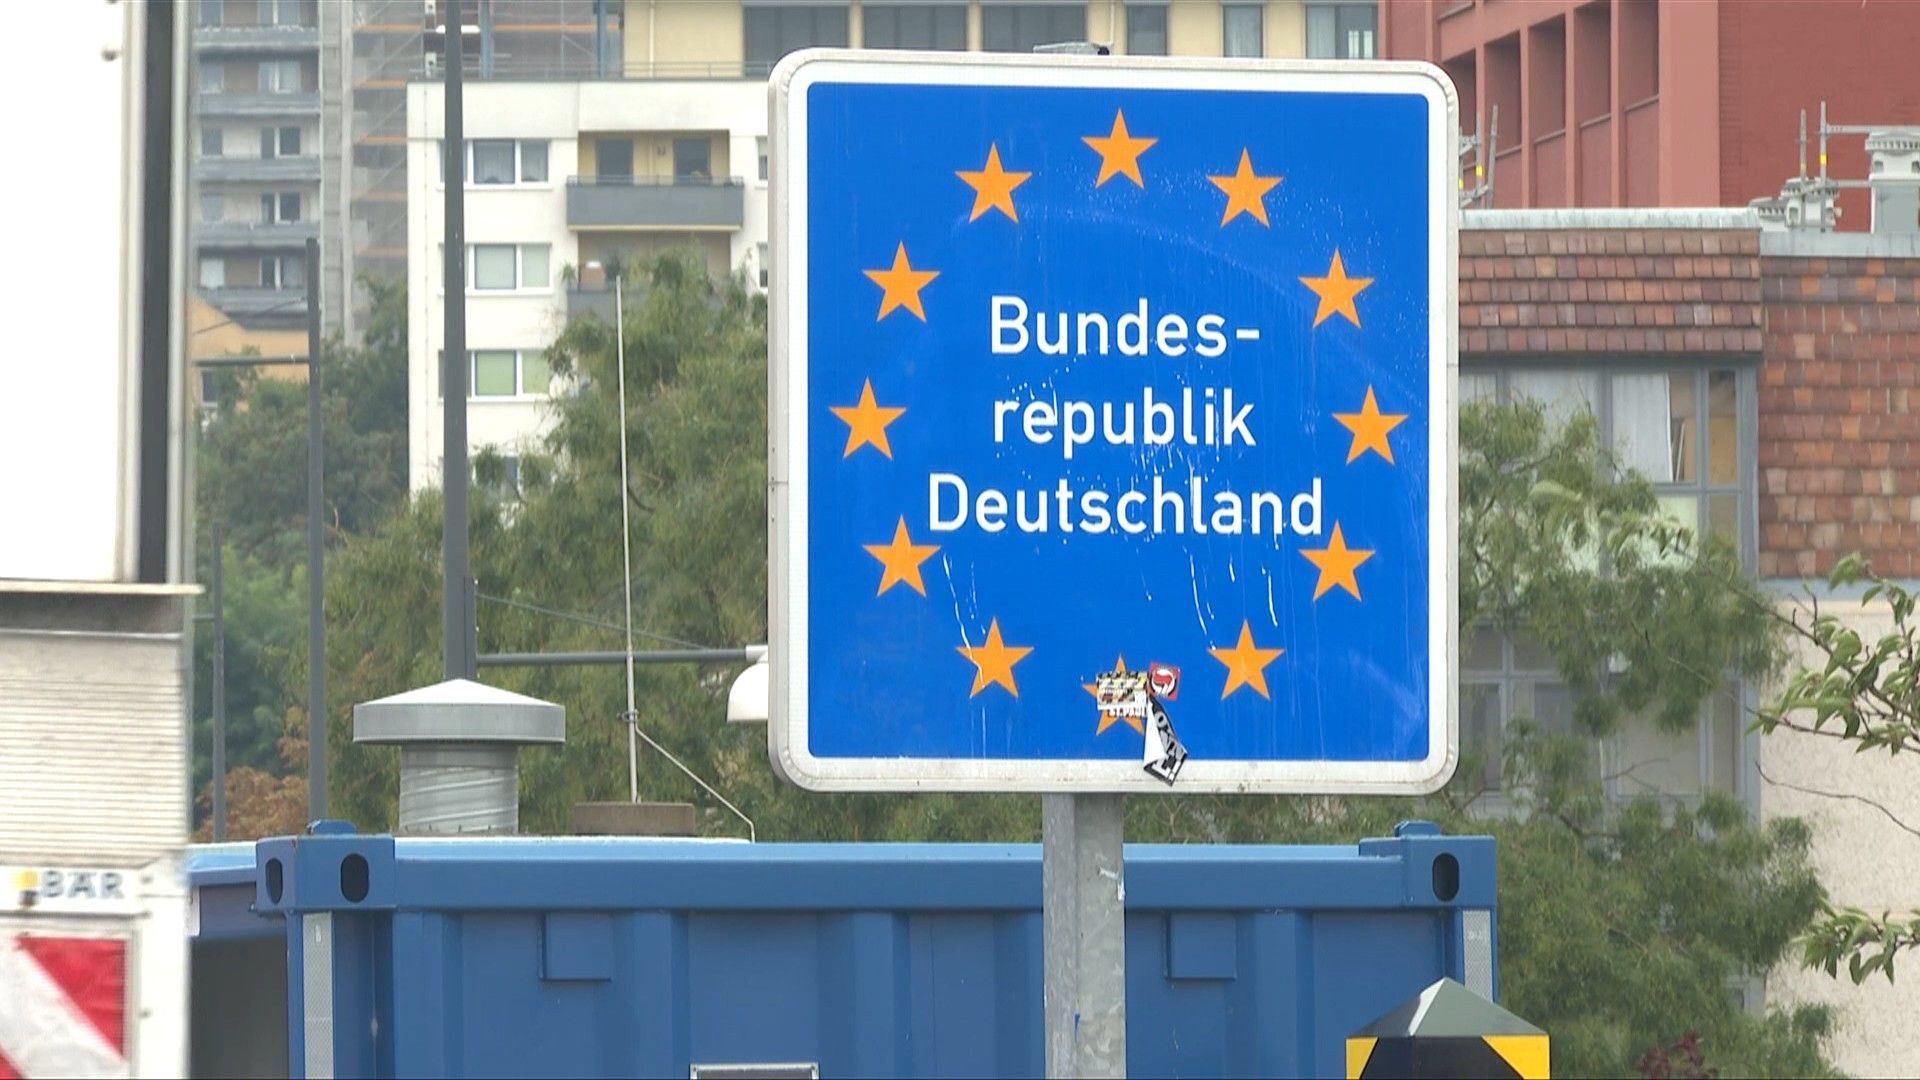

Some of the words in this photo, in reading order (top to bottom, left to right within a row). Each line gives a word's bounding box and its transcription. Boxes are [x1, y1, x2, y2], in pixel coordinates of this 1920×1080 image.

[991, 296, 1260, 357] Bundes-
[994, 387, 1256, 459] republik
[929, 473, 1323, 535] Deutschland
